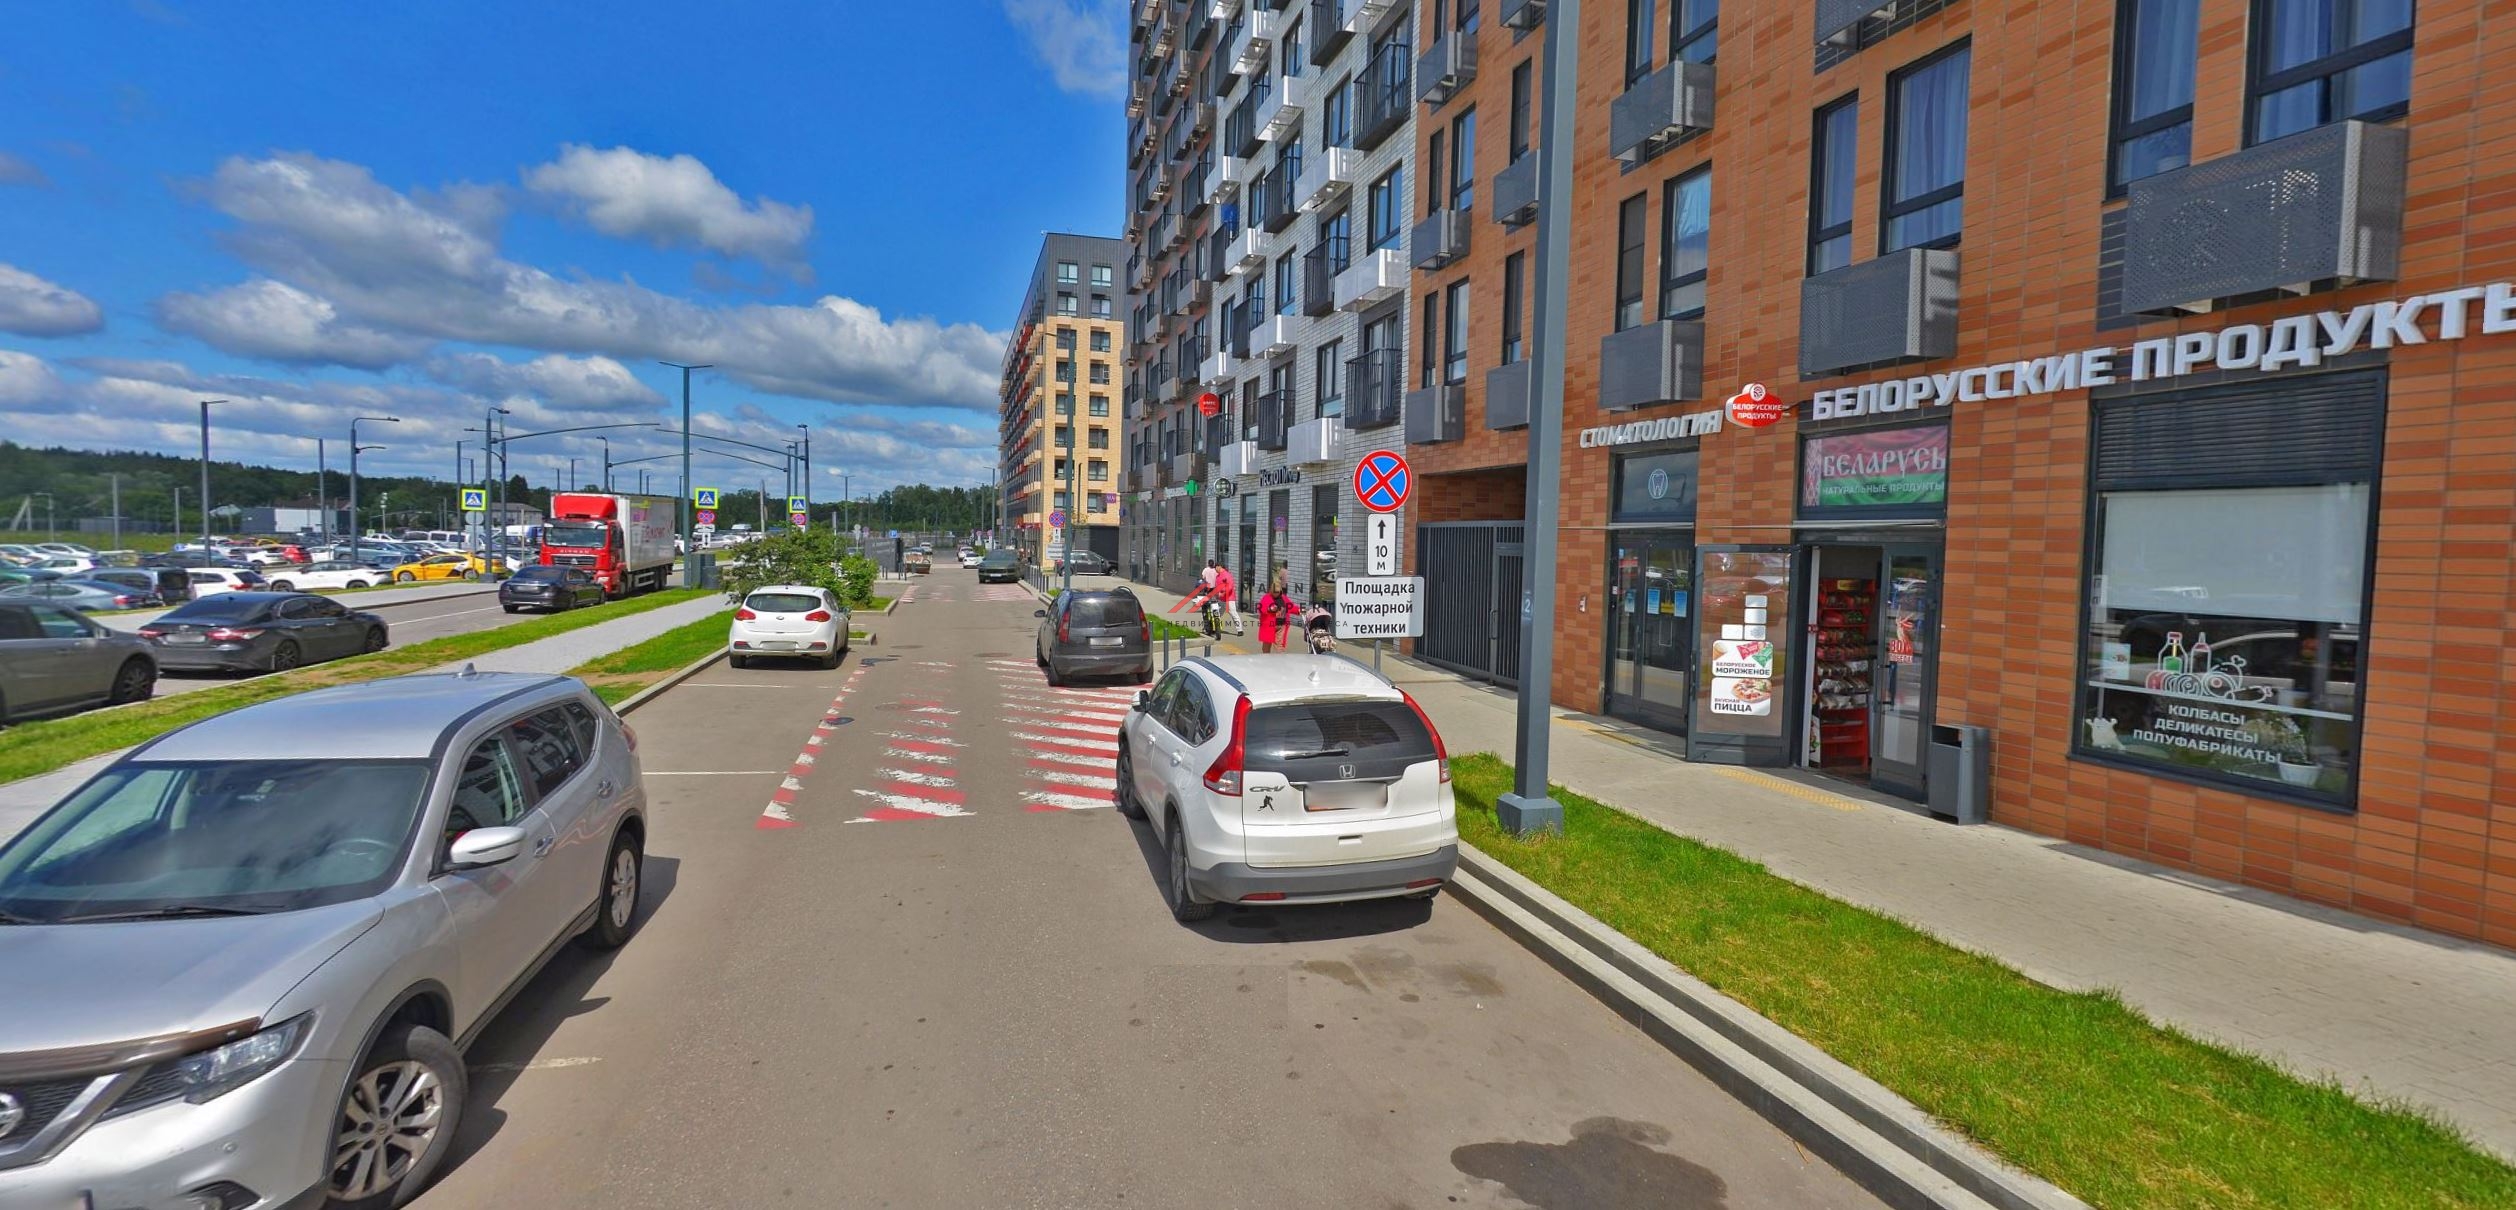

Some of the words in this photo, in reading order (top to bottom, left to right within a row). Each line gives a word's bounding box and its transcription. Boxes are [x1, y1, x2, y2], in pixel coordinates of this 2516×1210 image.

[1812, 347, 2117, 420] БЕЛОРУССКИЕ
[1732, 403, 1783, 411] БЕЛОРУССКИЕ
[1737, 412, 1777, 420] ПРОДУКТЫ
[1579, 410, 1723, 448] СТОМАТОЛОГИЯ
[1823, 484, 1888, 495] НАТУРАЛЬНЫЕ
[1890, 481, 1945, 494] ПРОДУКТЫ
[1375, 545, 1388, 558] 10
[1345, 582, 1415, 597] Площадка
[1353, 623, 1406, 634] техники
[1715, 667, 1770, 676] МОРОЖЕНОЕ
[1714, 702, 1752, 712] ПИЦЦА
[2168, 704, 2245, 726] КОЛБАСЫ
[2154, 718, 2258, 744] ДЕЛИКАТЕСЫ
[2133, 729, 2281, 763] ПОЛУФАБРИКАТЫ
